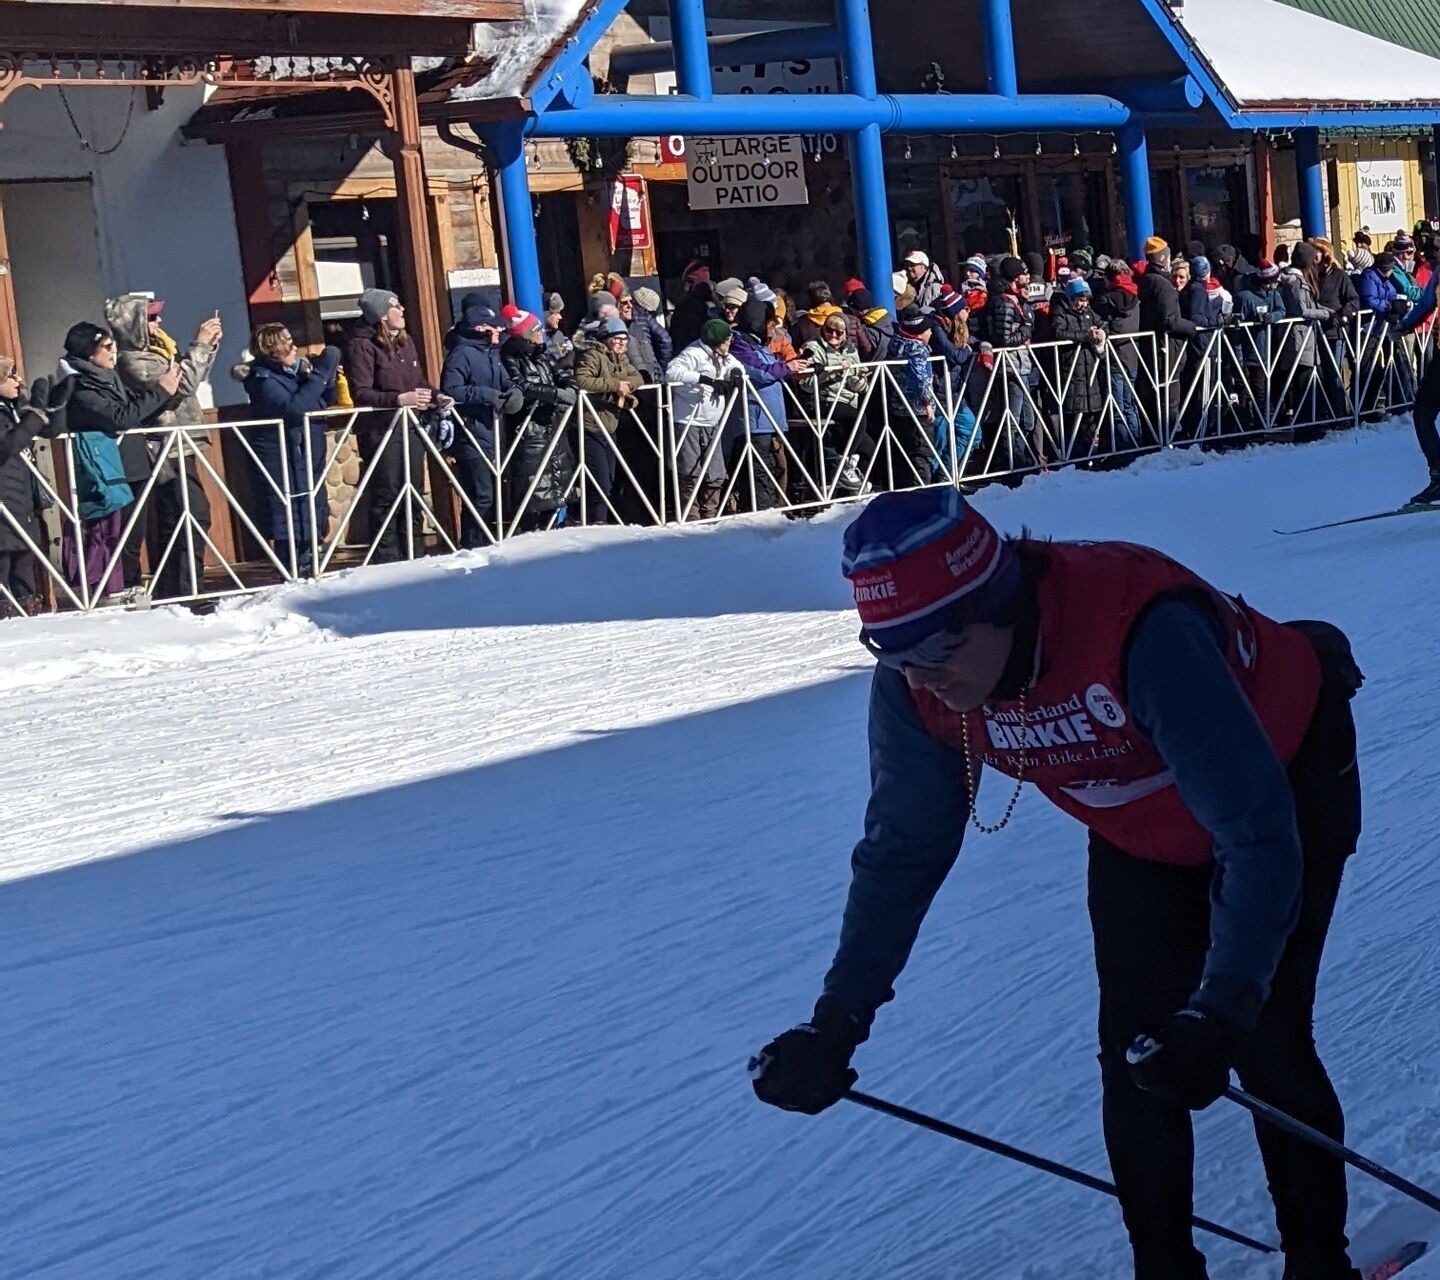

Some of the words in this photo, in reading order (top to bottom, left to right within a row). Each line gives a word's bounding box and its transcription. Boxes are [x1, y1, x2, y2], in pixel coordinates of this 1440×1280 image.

[721, 136, 791, 157] LARGE
[692, 161, 799, 184] OUTDOOR
[1361, 175, 1380, 189] Main
[1381, 174, 1403, 188] Street
[716, 185, 779, 205] PATIO
[1103, 703, 1117, 721] 8
[986, 713, 1098, 750] BIRKIE
